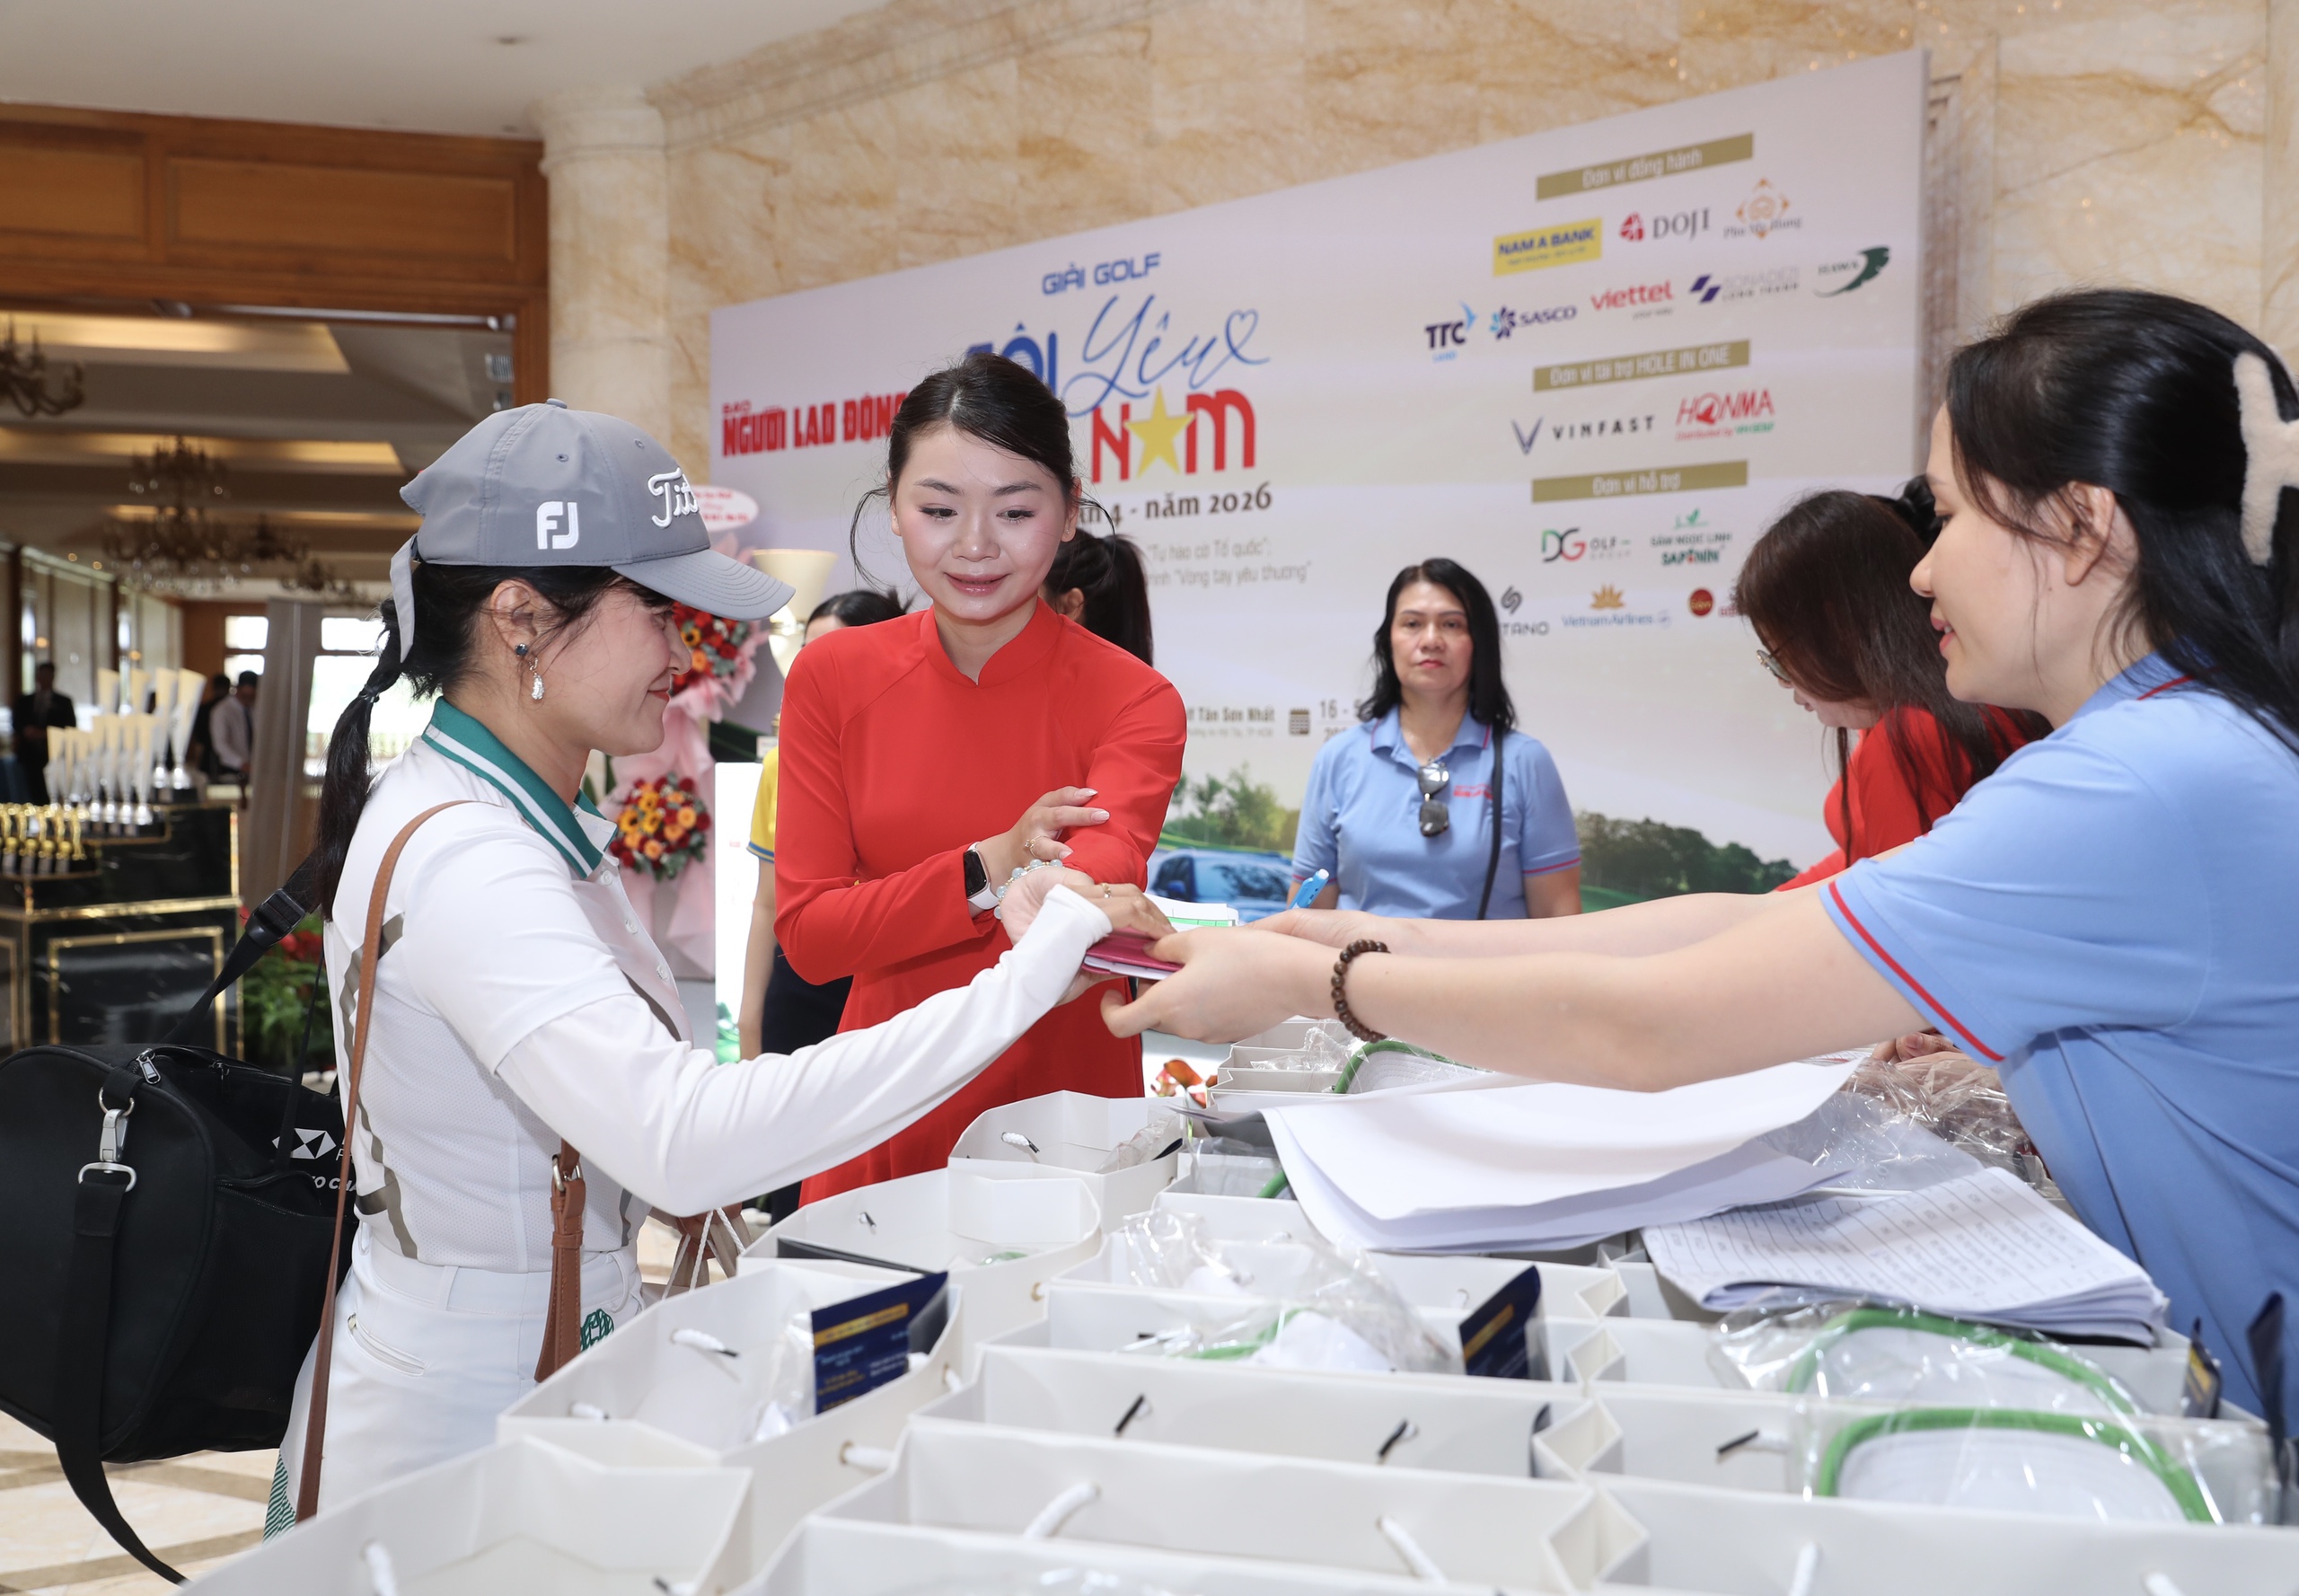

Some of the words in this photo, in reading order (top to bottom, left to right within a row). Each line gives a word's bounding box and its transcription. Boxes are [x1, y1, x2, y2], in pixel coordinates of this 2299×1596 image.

[1652, 207, 1711, 241] DOJI
[1499, 237, 1536, 257] NAM
[1537, 235, 1551, 250] A
[1551, 227, 1595, 247] BANK
[1094, 252, 1161, 286] GOLF
[1590, 280, 1674, 311] viettel
[1519, 305, 1577, 328] SASCO
[1425, 321, 1467, 349] TTC
[1636, 351, 1675, 376] HOLE
[1679, 349, 1696, 371] IN
[1698, 344, 1731, 368] ONE
[1676, 388, 1775, 427] HONMA
[794, 401, 836, 447] LAO
[1553, 414, 1656, 440] VINFAST
[1145, 491, 1200, 519] năm
[1208, 481, 1273, 515] 2026
[536, 500, 579, 550] FJ
[1319, 699, 1338, 719] 16
